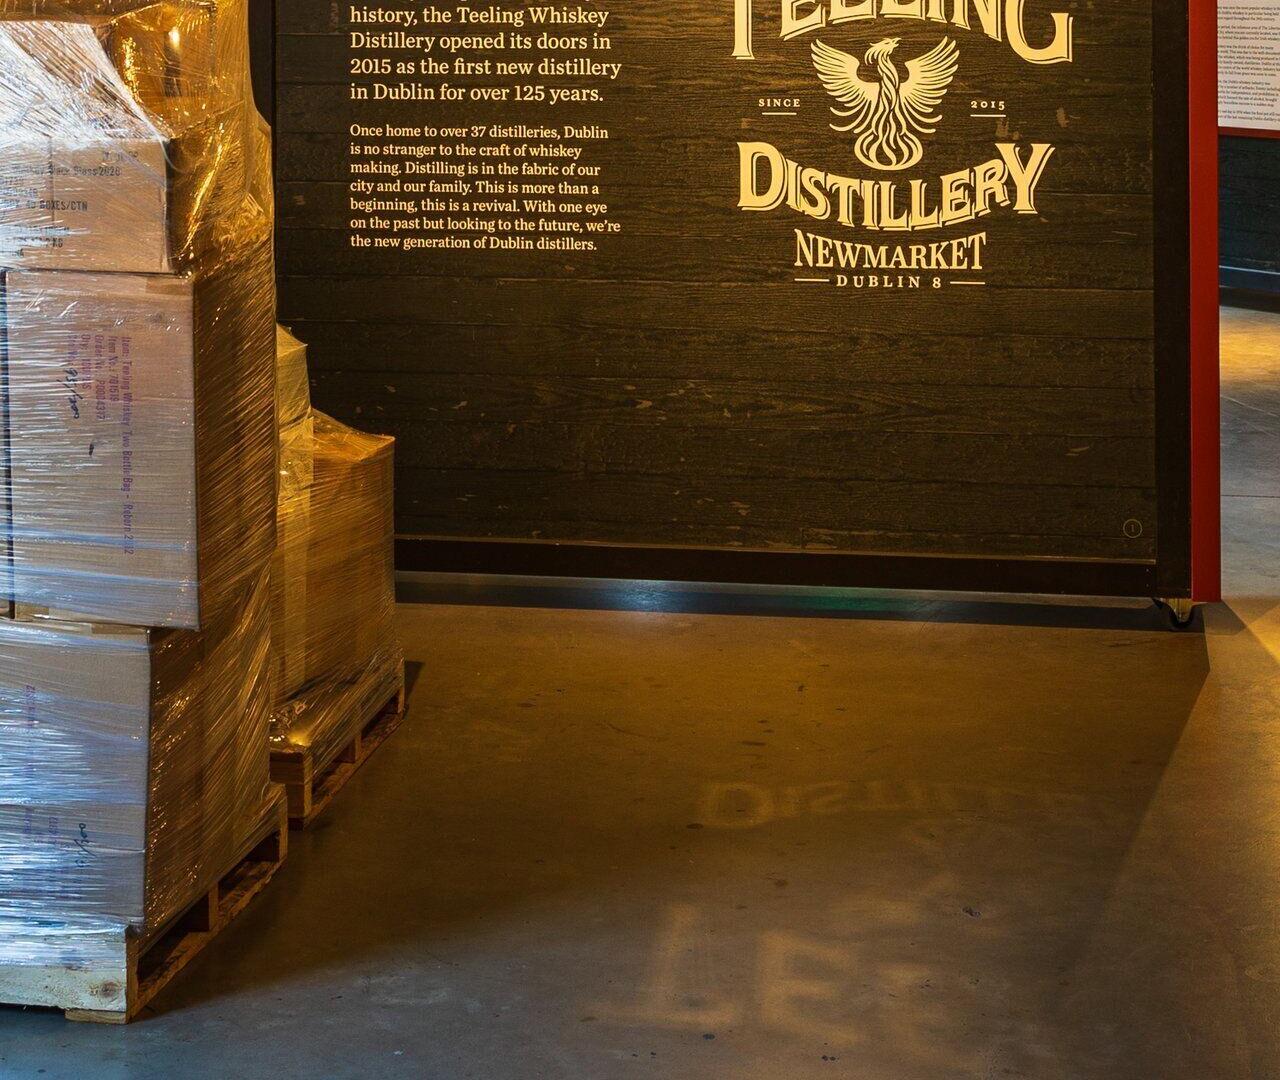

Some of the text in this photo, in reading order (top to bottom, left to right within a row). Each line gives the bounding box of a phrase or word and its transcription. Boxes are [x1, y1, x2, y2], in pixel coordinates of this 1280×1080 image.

[350, 6, 609, 28] history, the Teeling Whiskey
[350, 31, 612, 53] Distillery opened its doors in
[350, 57, 622, 80] 2015 as the first new distillery
[350, 82, 604, 105] in Dublin for over 125 years.
[758, 98, 801, 108] SINCE
[970, 100, 1005, 111] 2015
[350, 123, 609, 140] Once home to over 37 distilleries, Dublin
[350, 142, 582, 160] is no stranger to the craft of whiskey
[350, 160, 601, 178] making. Distilling is in the fabric of our
[736, 140, 1055, 231] DISTILLERY
[350, 234, 597, 251] the new generation of Dublin distillers.
[794, 228, 986, 271] NEWMARKET
[836, 274, 941, 289] DUBLIN 8
